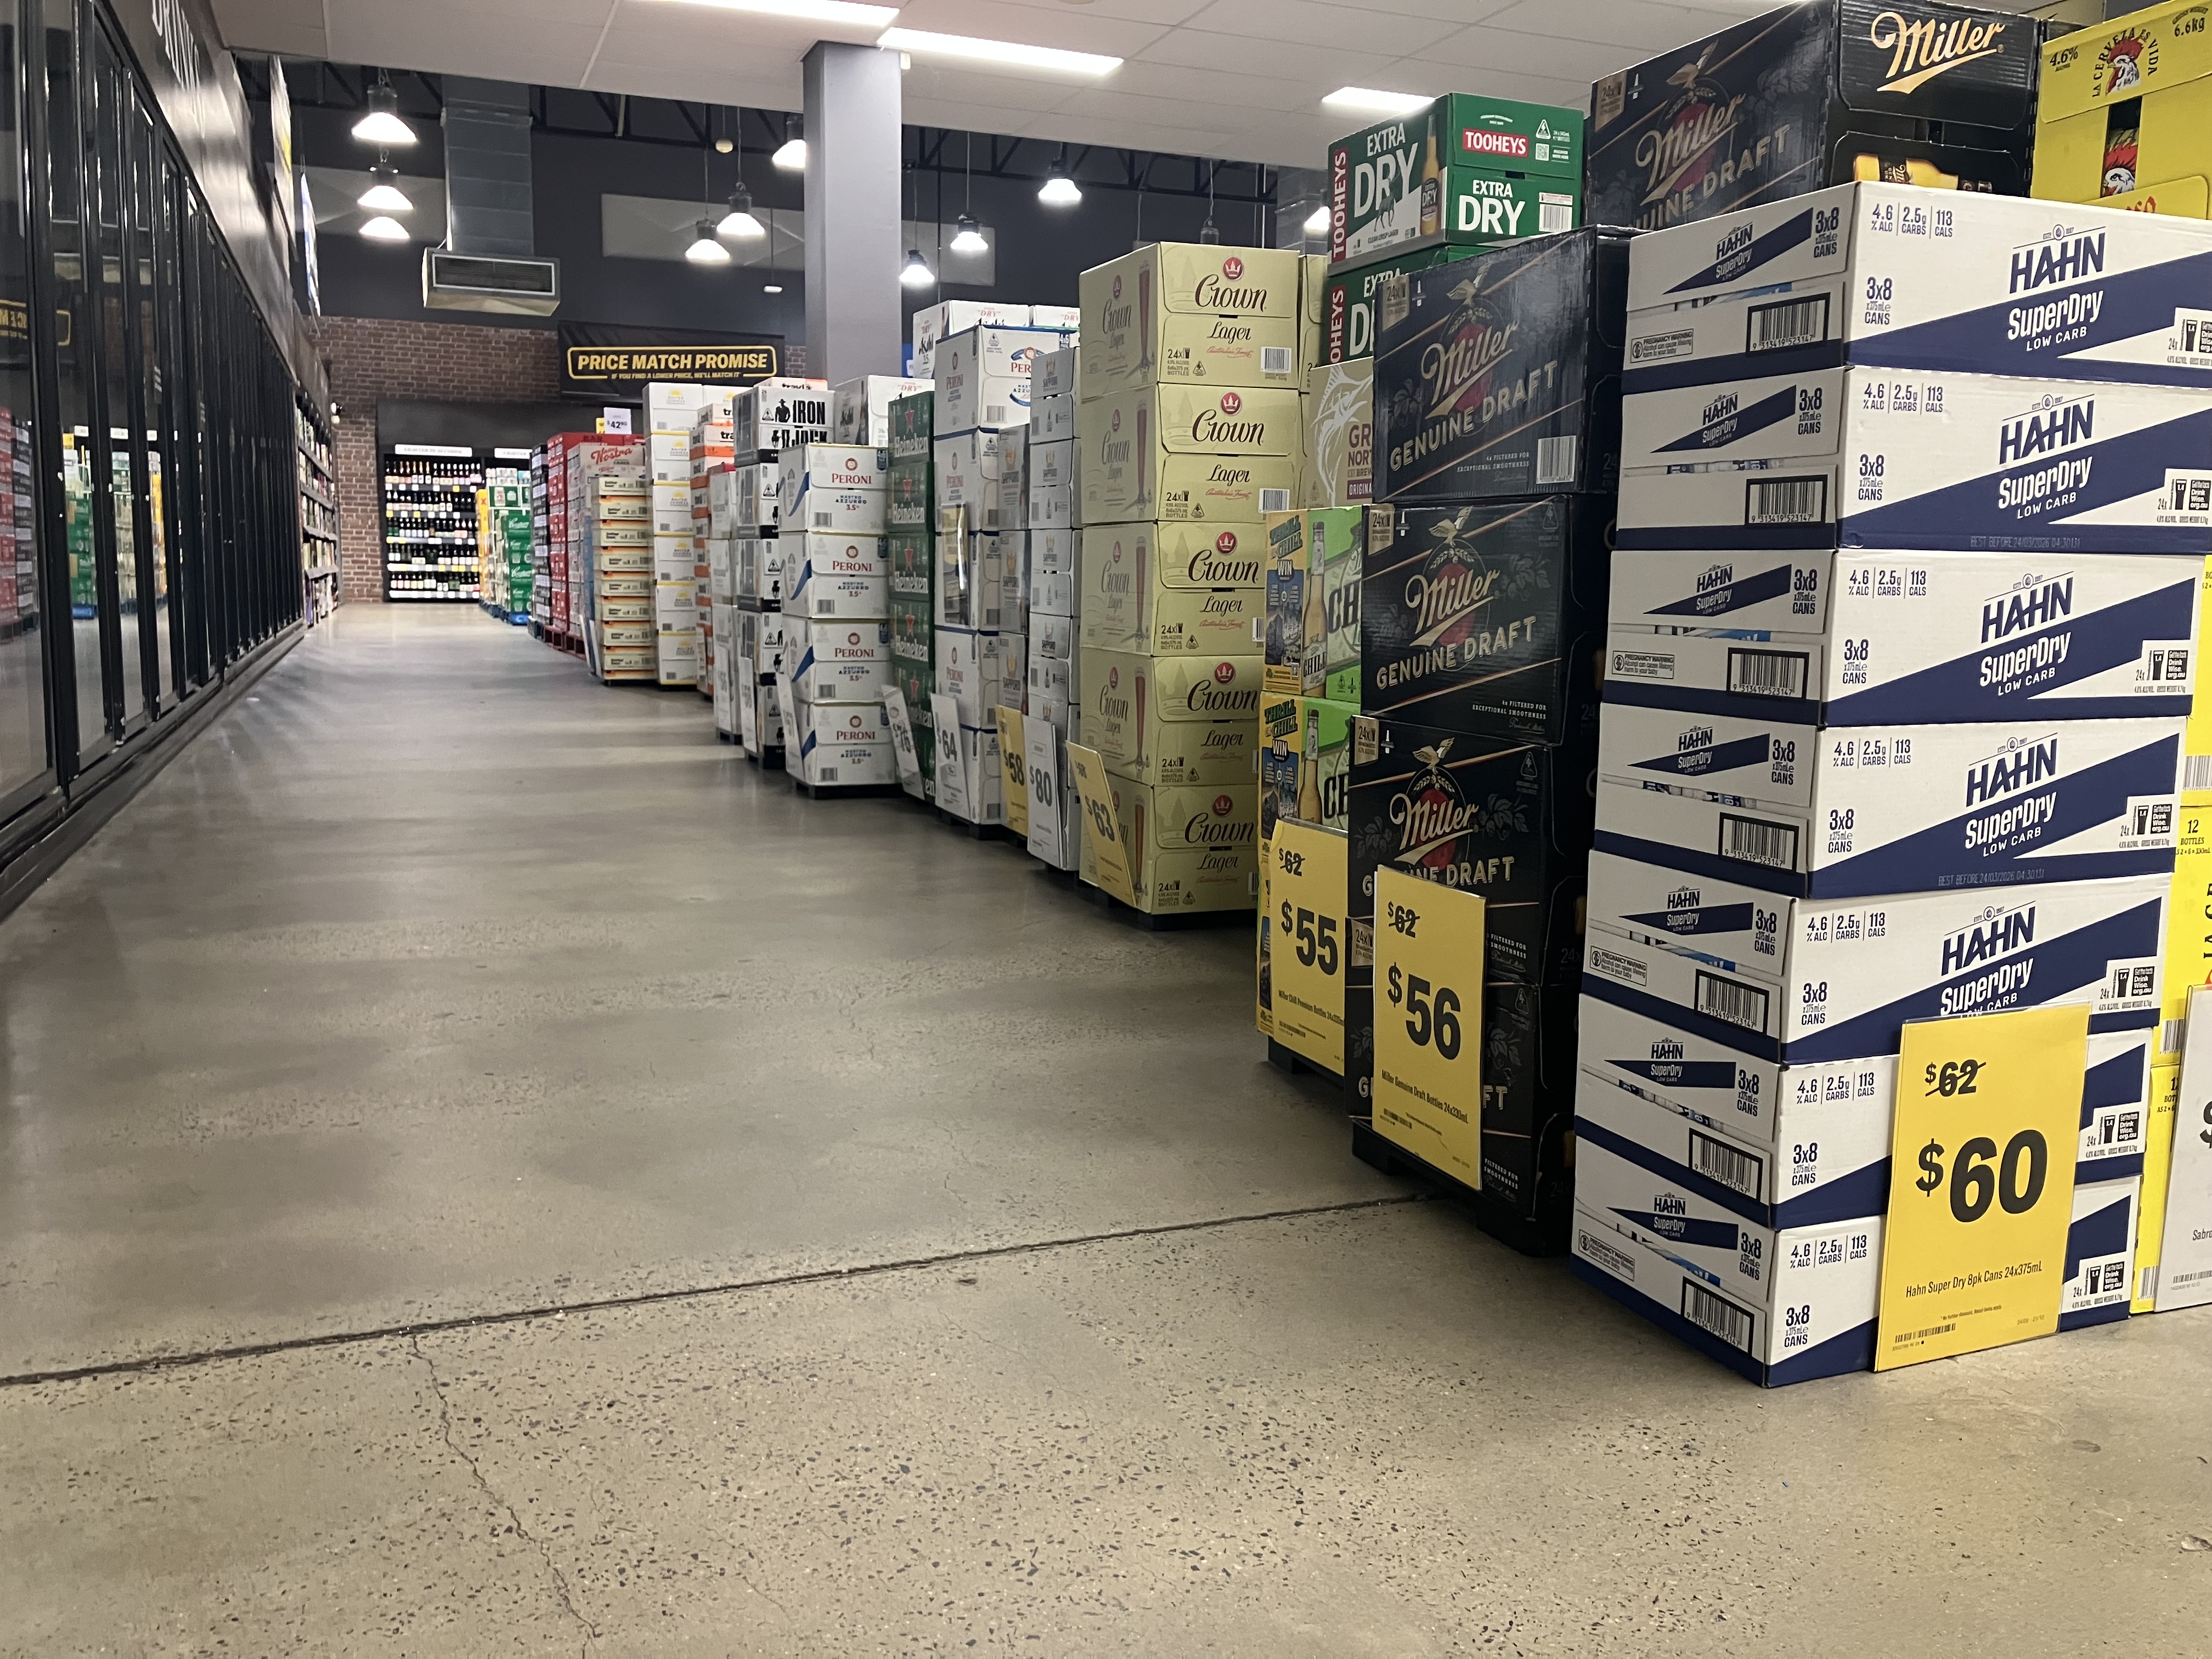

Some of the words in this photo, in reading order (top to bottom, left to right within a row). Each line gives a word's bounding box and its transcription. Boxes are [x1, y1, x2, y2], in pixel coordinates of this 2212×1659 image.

[2140, 29, 2151, 43] ES
[2174, 18, 2205, 37] 6.6kg
[1871, 11, 2005, 79] Miller
[2050, 46, 2078, 66] 4.6%
[2093, 28, 2135, 80] CERVEZA
[2148, 38, 2159, 76] VIDA
[2092, 84, 2101, 98] LA
[1367, 123, 1406, 157] EXTRA
[1465, 132, 1526, 154] TOOHEYS
[1636, 93, 1746, 191] Miller
[1703, 125, 1790, 199] DRAFT
[1355, 143, 1418, 218] DRY
[1473, 179, 1513, 198] EXTRA
[1333, 151, 1347, 258] TOOHEYS
[1459, 195, 1525, 235] DRY
[1872, 204, 1893, 221] 4.6
[1903, 207, 1927, 226] 2.5g
[1936, 210, 1953, 226] 113
[1716, 227, 1753, 260] HAHN
[1902, 223, 1926, 235] CARBS
[1935, 227, 1953, 238] CALS
[1716, 249, 1752, 279] SuperDry
[2010, 233, 2106, 294] HAHN
[1195, 274, 1267, 312] Crown
[1866, 276, 1893, 301] 3x8
[1102, 302, 1131, 336] Crown
[1864, 312, 1890, 325] CANS
[2007, 290, 2103, 341] SuperDry
[1206, 321, 1251, 344] Lager
[2026, 337, 2052, 352] LOW
[2055, 326, 2087, 344] CARB
[578, 355, 629, 370] PRICE
[632, 354, 692, 369] MATCH
[695, 354, 768, 369] PROMISE
[1421, 321, 1519, 405] Miller
[901, 384, 918, 392] DRY
[793, 400, 825, 425] IRON
[1192, 409, 1264, 445] Crown
[1390, 406, 1474, 471] GENUINE
[1482, 360, 1558, 423] DRAFT
[894, 433, 928, 458] Heineken
[1999, 400, 2095, 465] HAHN
[832, 473, 871, 484] PERONI
[1206, 464, 1250, 485] Lager
[1349, 481, 1372, 495] ORIGINA
[1998, 456, 2093, 509] SuperDry
[893, 503, 925, 523] Heineken
[2017, 503, 2041, 520] LOW
[2046, 492, 2076, 510] CARB
[832, 561, 872, 572] PERONI
[1188, 550, 1258, 584] Crown
[1794, 569, 1817, 592] 3x8
[1199, 595, 1243, 613] Lager
[1406, 569, 1500, 634] Miller
[1792, 602, 1815, 615] CANS
[1982, 577, 2073, 644] HAHN
[834, 647, 874, 657] PERONI
[895, 635, 928, 661] Heineken
[1376, 642, 1457, 690] GENUINE
[1464, 616, 1536, 662] DRAFT
[1980, 631, 2072, 686] SuperDry
[1998, 680, 2022, 696] LOW
[2025, 667, 2056, 686] CARB
[1099, 686, 1128, 722] Crown
[1187, 680, 1257, 714] Crown
[1472, 704, 1506, 714] EXCEPTIONAL
[1509, 710, 1546, 719] SMOOTHNESS
[1509, 701, 1534, 709] FILTERED
[836, 731, 876, 740] PERONI
[1200, 730, 1244, 750] Lager
[1272, 716, 1297, 738] CHILL
[936, 727, 957, 762] $64
[1273, 740, 1288, 756] WIN
[1030, 765, 1052, 808] $80
[1966, 738, 2057, 808] HAHN
[1085, 795, 1115, 842] $63
[1185, 812, 1254, 844] Crown
[1390, 793, 1479, 850] Miller
[1830, 809, 1854, 830] 3x8
[1965, 792, 2057, 849] SuperDry
[2187, 819, 2199, 833] 12
[1828, 841, 1852, 853] CANS
[1983, 842, 2007, 857] LOW
[2011, 827, 2041, 846] CARB
[2181, 837, 2204, 846] BOTTLES
[1197, 853, 1239, 873] Lager
[1279, 848, 1304, 877] $62
[1446, 856, 1514, 887] DRAFT
[1938, 876, 1954, 886] BEST
[1956, 873, 1978, 884] BEFORE
[1388, 900, 1419, 938] $62
[1808, 916, 1827, 932] 4.6
[1837, 915, 1860, 930] 2.5g
[1870, 913, 1885, 927] 113
[1836, 928, 1860, 939] CARBS
[1868, 927, 1886, 937] CALS
[1281, 898, 1338, 975] $55
[1942, 906, 2035, 977] HAHN
[1940, 958, 2034, 1016] SuperDry
[1388, 962, 1460, 1060] $56
[1988, 992, 2018, 1012] CARB
[1651, 1043, 1683, 1059] HAHN
[1651, 1064, 1683, 1078] SuperDry
[1925, 1060, 1984, 1097] $62
[1381, 1069, 1394, 1084] Miller
[1395, 1076, 1413, 1094] Genuine
[1414, 1086, 1426, 1101] Draft
[1426, 1093, 1443, 1110] Bottles
[1916, 1129, 2047, 1223] $60
[1906, 1284, 1926, 1297] Hahn
[1928, 1280, 1951, 1294] Super
[1953, 1277, 1966, 1289] Dry
[1967, 1272, 1982, 1287] 8pk
[1984, 1270, 2002, 1282] Cans
[2005, 1261, 2042, 1278] 24x375mL
[1786, 1305, 1810, 1327] 3x8
[1784, 1334, 1808, 1347] CANS
